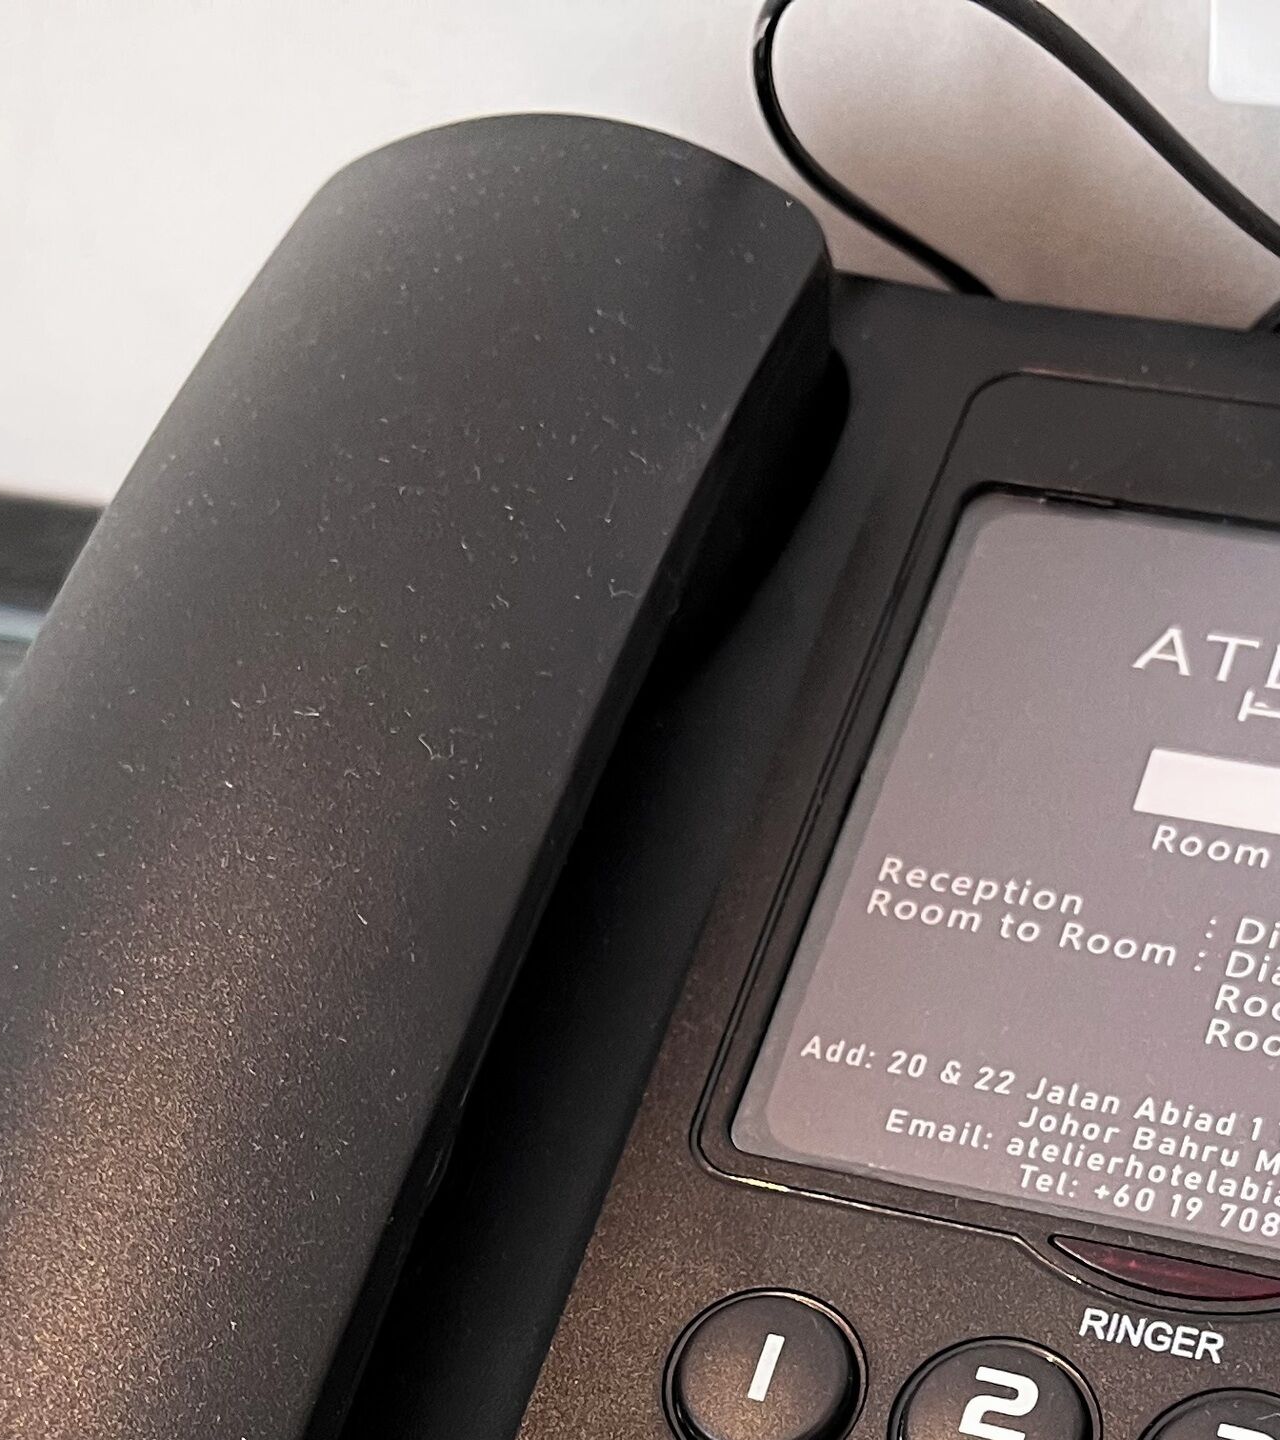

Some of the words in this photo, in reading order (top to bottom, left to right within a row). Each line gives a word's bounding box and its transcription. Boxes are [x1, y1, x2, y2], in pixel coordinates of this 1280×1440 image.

[1151, 825, 1269, 869] Room
[879, 856, 1083, 915] Reception
[867, 888, 981, 933] Room
[1000, 914, 1041, 943] to
[1059, 922, 1176, 966] Room
[800, 1035, 876, 1070] Add:
[887, 1050, 928, 1079] 20
[940, 1061, 962, 1086] &
[973, 1067, 1016, 1096] 22
[1026, 1077, 1121, 1116] Jalan
[1133, 1096, 1236, 1137] Abiad
[1250, 1117, 1264, 1141] 1
[885, 1109, 994, 1151] Email:
[1019, 1106, 1120, 1144] Johor
[1133, 1129, 1240, 1168] Bahru
[1019, 1164, 1078, 1200] Tel:
[1094, 1182, 1154, 1213] +60
[1171, 1194, 1204, 1222] 19
[1078, 1307, 1224, 1364] RINGER
[747, 1333, 785, 1402] 1
